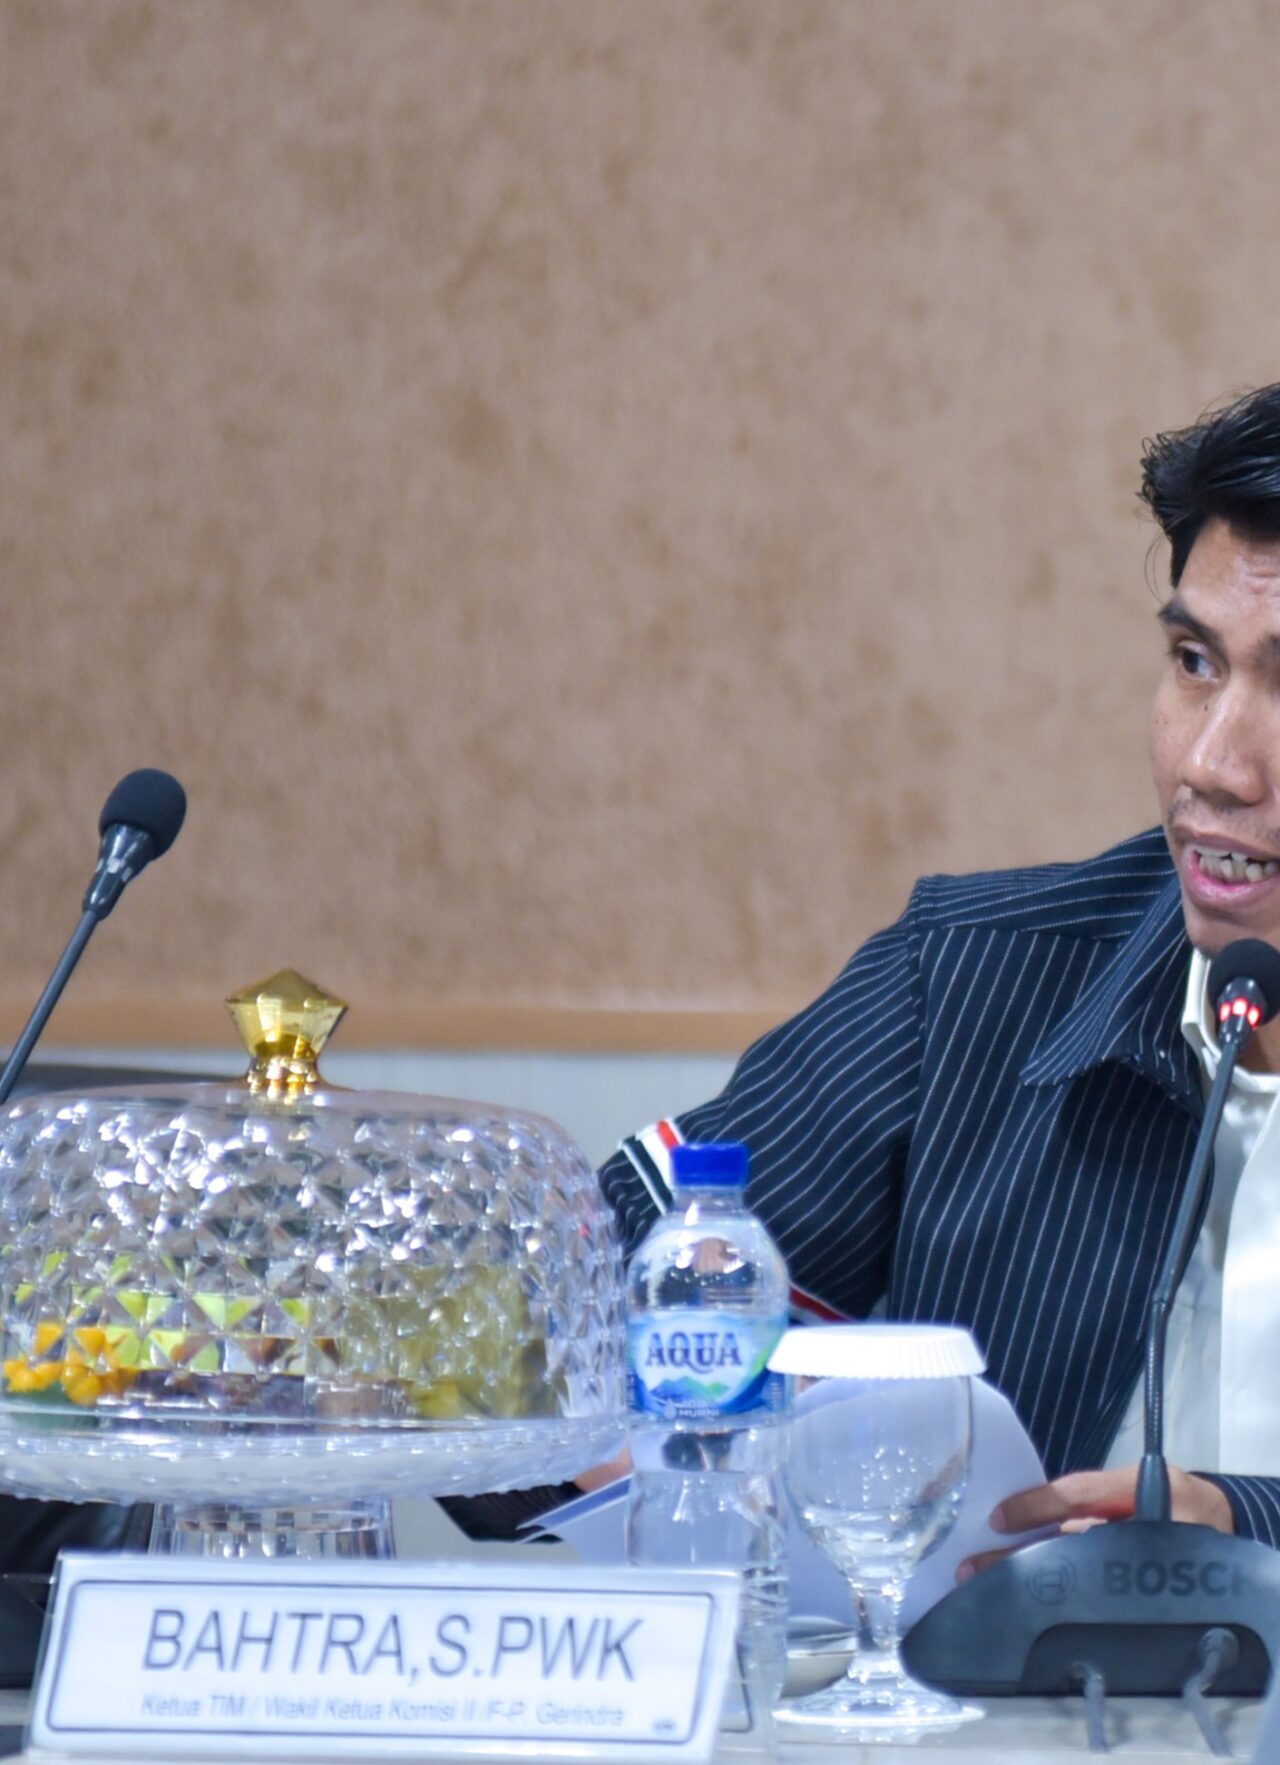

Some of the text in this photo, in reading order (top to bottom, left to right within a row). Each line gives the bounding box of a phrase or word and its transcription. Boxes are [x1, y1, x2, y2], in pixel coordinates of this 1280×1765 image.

[645, 1330, 743, 1374] AQUA
[141, 1607, 645, 1684] BAHTRA,S.PWK
[141, 1692, 201, 1717] Ketua
[265, 1694, 320, 1719] Wakil
[325, 1696, 384, 1721] Ketua
[388, 1698, 456, 1722] Komisi
